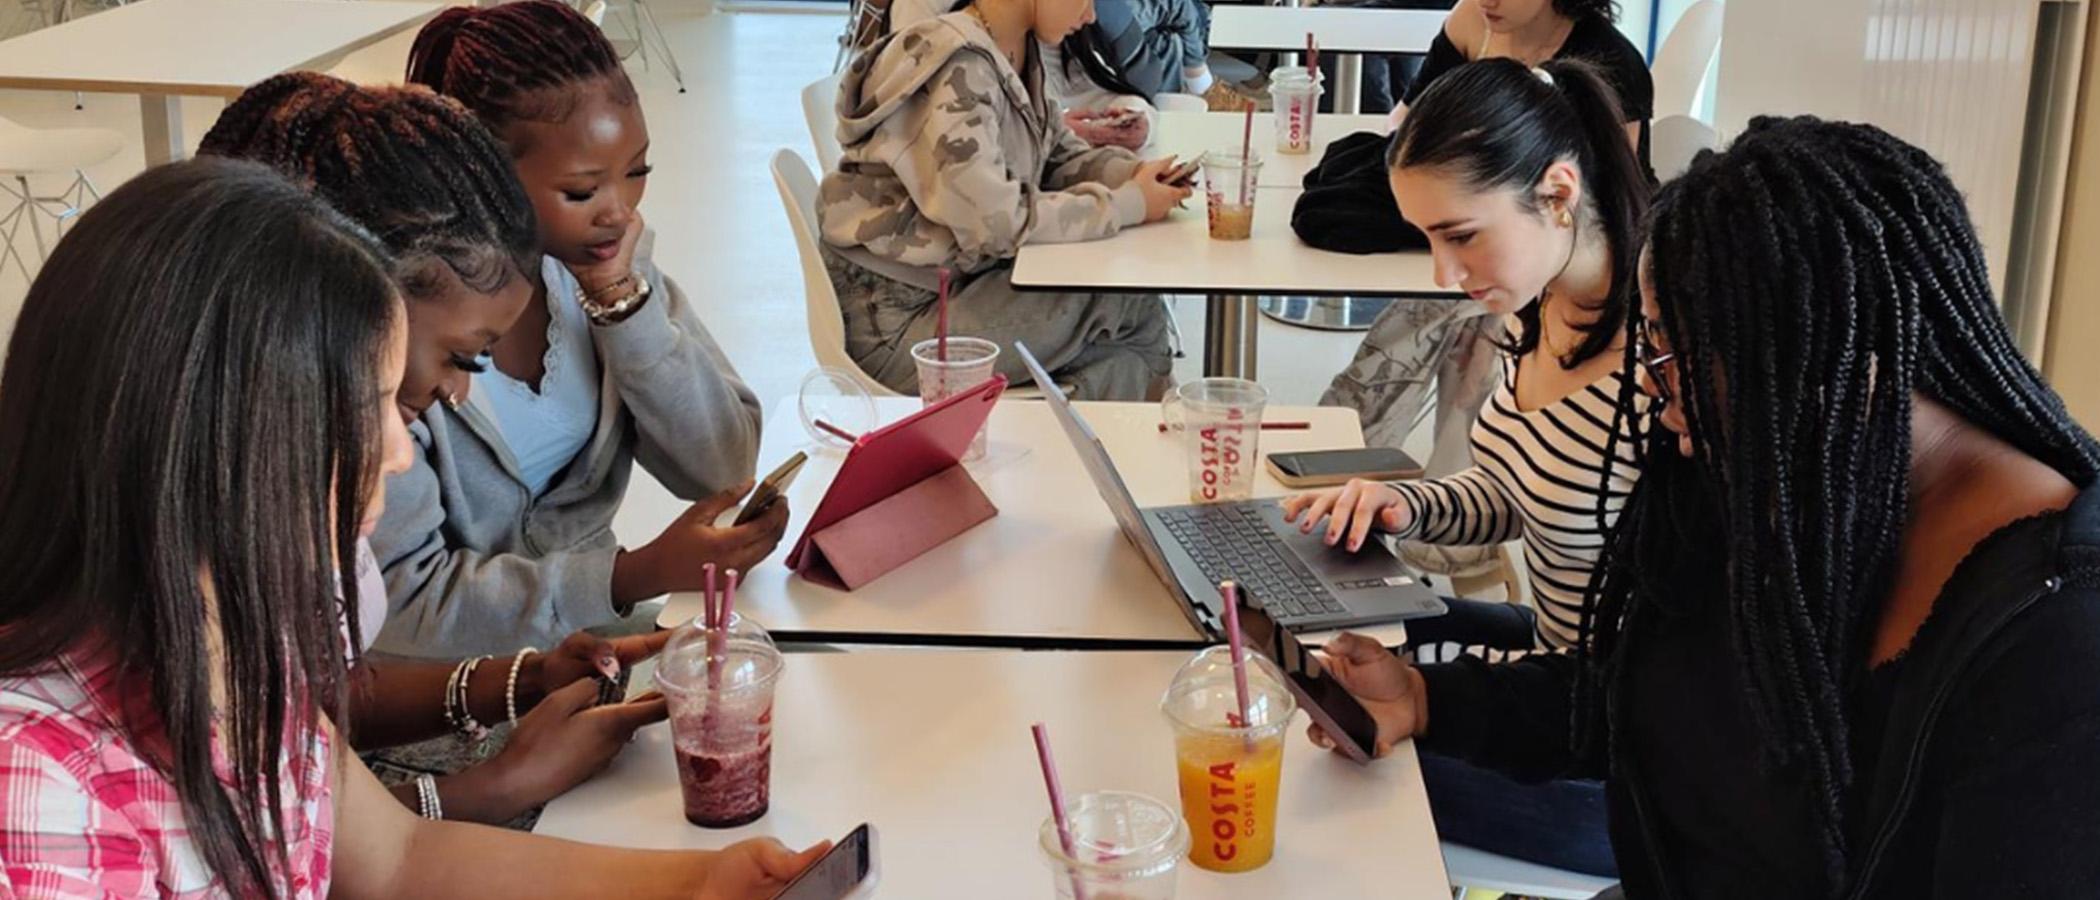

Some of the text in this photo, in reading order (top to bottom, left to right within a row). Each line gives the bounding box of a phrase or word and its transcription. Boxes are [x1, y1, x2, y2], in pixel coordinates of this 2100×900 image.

[1290, 106, 1301, 149] COSTA
[1200, 427, 1219, 500] COSTA
[1209, 762, 1239, 862] COSTA
[1244, 782, 1256, 838] COFFEE
